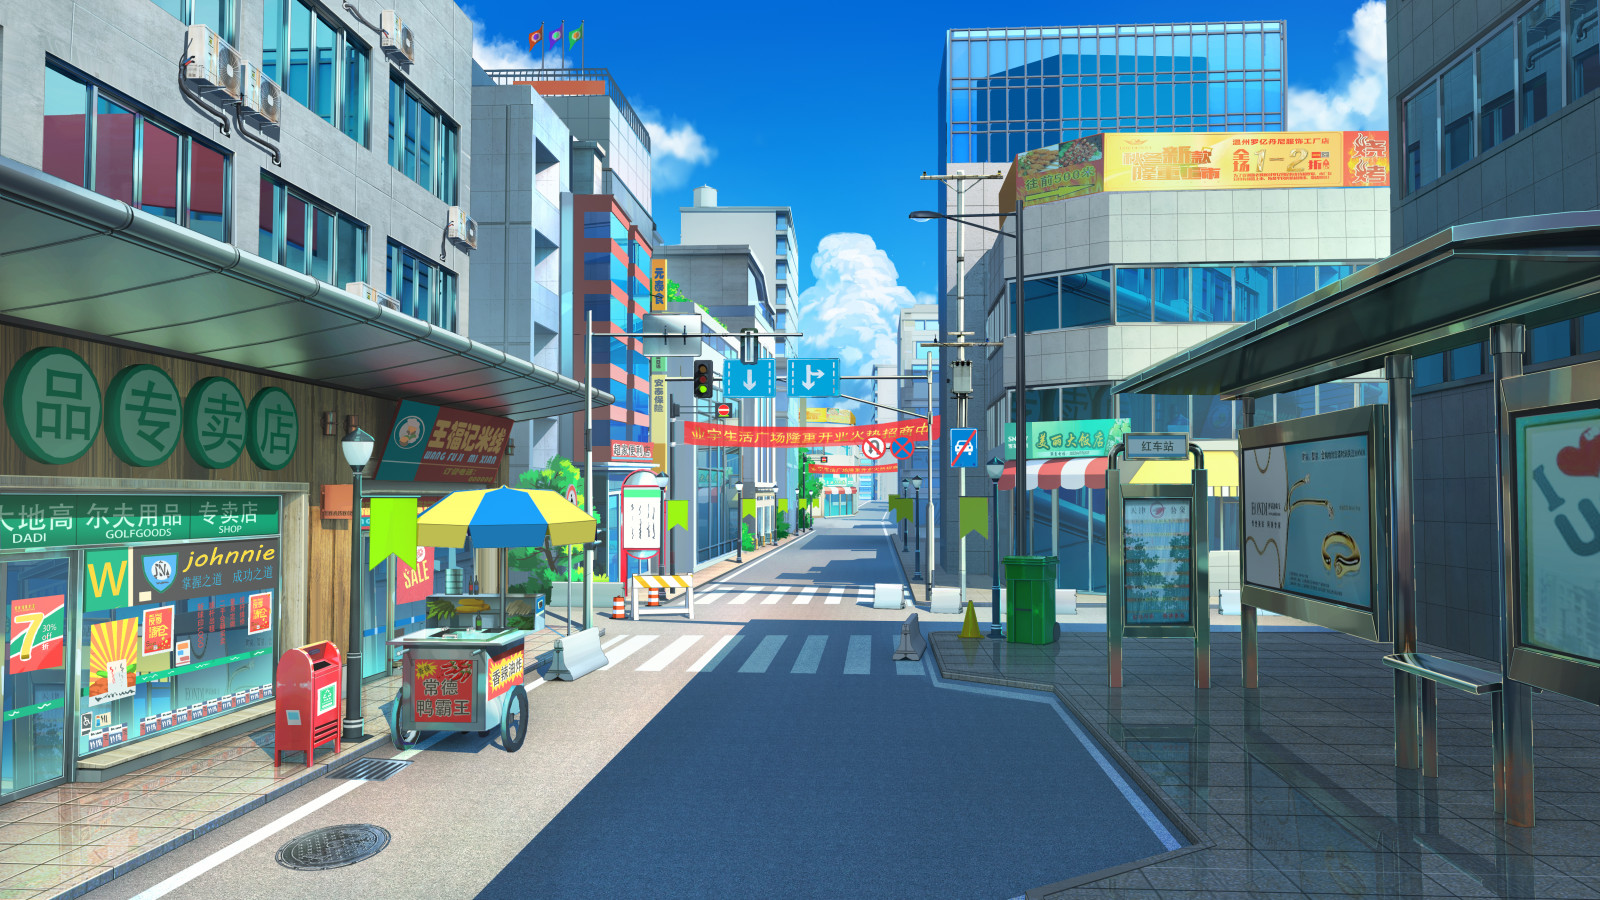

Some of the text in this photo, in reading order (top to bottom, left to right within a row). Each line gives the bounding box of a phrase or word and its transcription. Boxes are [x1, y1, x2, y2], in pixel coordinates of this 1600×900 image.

[1352, 133, 1387, 183] 烧烤
[1025, 166, 1096, 190] 往前500米
[35, 368, 294, 455] 品专卖店
[428, 419, 507, 454] 王福记米线
[1036, 431, 1106, 450] 美丽大饭店
[1141, 440, 1174, 452] 红车站
[1533, 464, 1600, 557] I U
[12, 525, 242, 544] DADI GOLFGOODS SHOP
[182, 544, 275, 573] johnnie
[87, 560, 128, 598] W
[182, 565, 273, 591] 掌握之道 成功之道
[403, 559, 430, 589] SALE
[14, 612, 44, 661] 7
[41, 631, 52, 641] off
[42, 623, 57, 633] 30%
[492, 657, 522, 687] 香辣油炸
[423, 678, 459, 696] 常德
[416, 699, 471, 717] 鸭霸王
